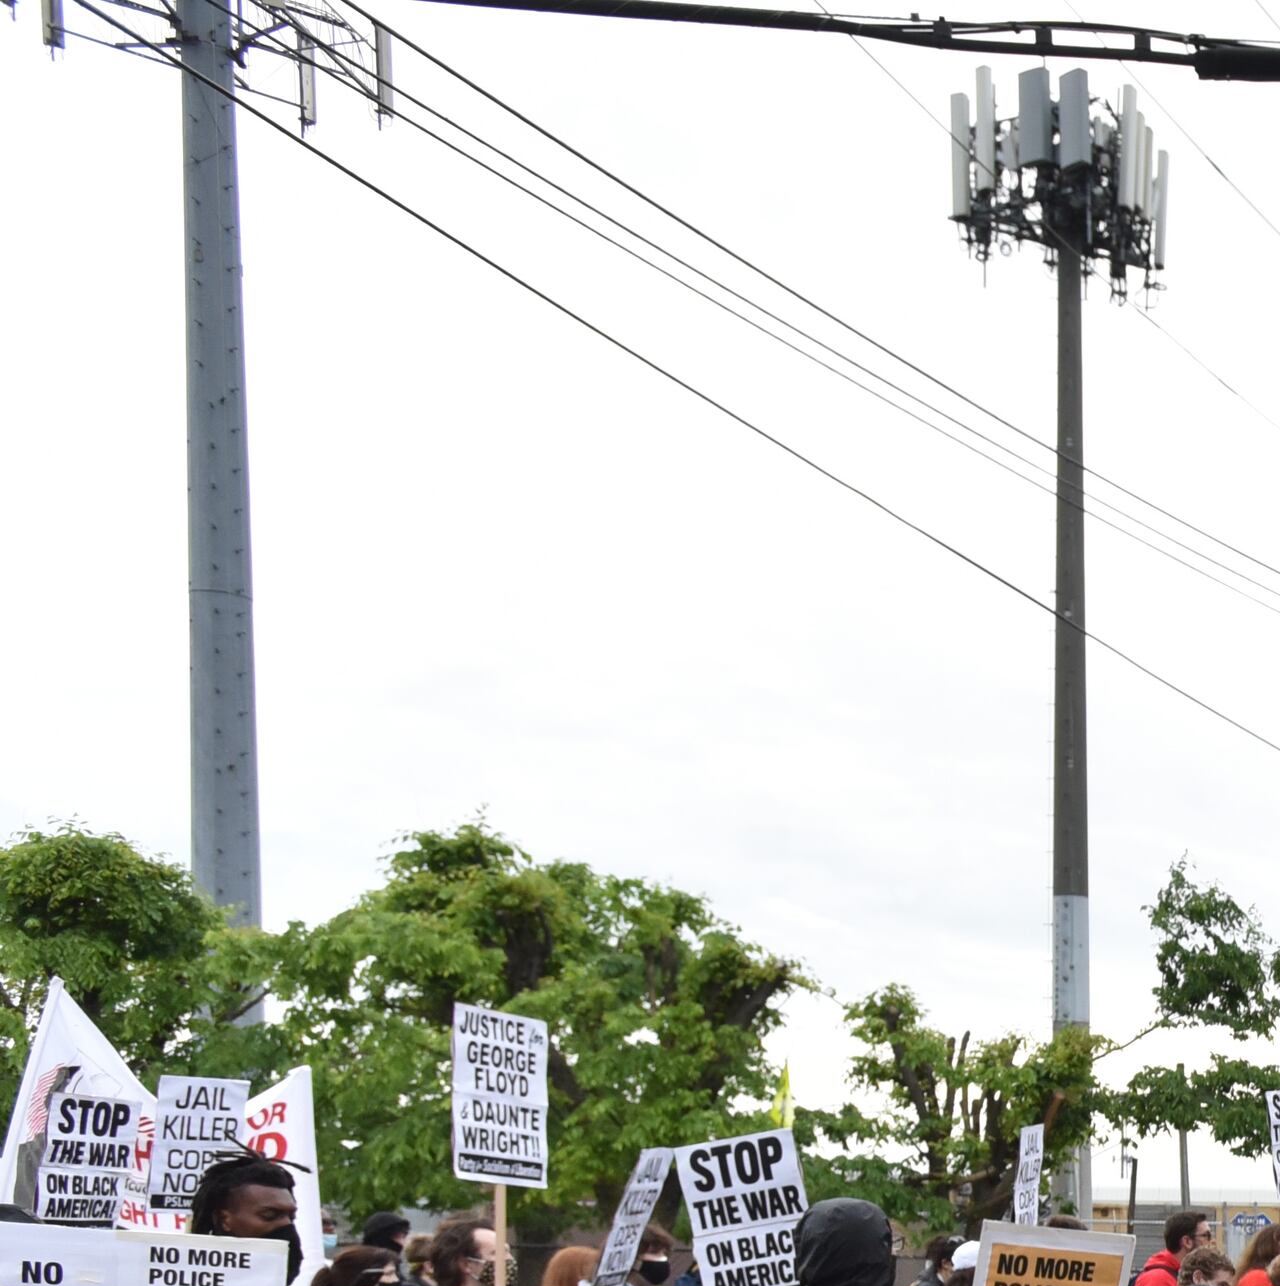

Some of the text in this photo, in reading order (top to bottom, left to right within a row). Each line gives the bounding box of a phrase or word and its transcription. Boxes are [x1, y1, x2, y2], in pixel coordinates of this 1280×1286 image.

[460, 1011, 544, 1048] JUSTICE for
[467, 1041, 536, 1075] GEORGE
[474, 1067, 529, 1097] FLOYD
[175, 1085, 232, 1111] JAIL
[58, 1098, 131, 1137] STOP
[163, 1115, 238, 1141] KILLER
[472, 1099, 540, 1131] DAUNTE
[49, 1139, 86, 1164] THE
[88, 1142, 130, 1168] WAR
[462, 1125, 540, 1157] WRIGHT!!
[168, 1149, 217, 1170] COP
[690, 1136, 783, 1192] STOP
[46, 1174, 69, 1194] ON
[72, 1175, 119, 1196] BLACK
[162, 1173, 204, 1194] NO
[44, 1198, 117, 1219] AMERICA!
[693, 1185, 804, 1230] THE WAR
[150, 1246, 251, 1269] NO MORE
[706, 1240, 735, 1267] ON
[997, 1253, 1095, 1282] NO MORE
[21, 1260, 63, 1285] NO
